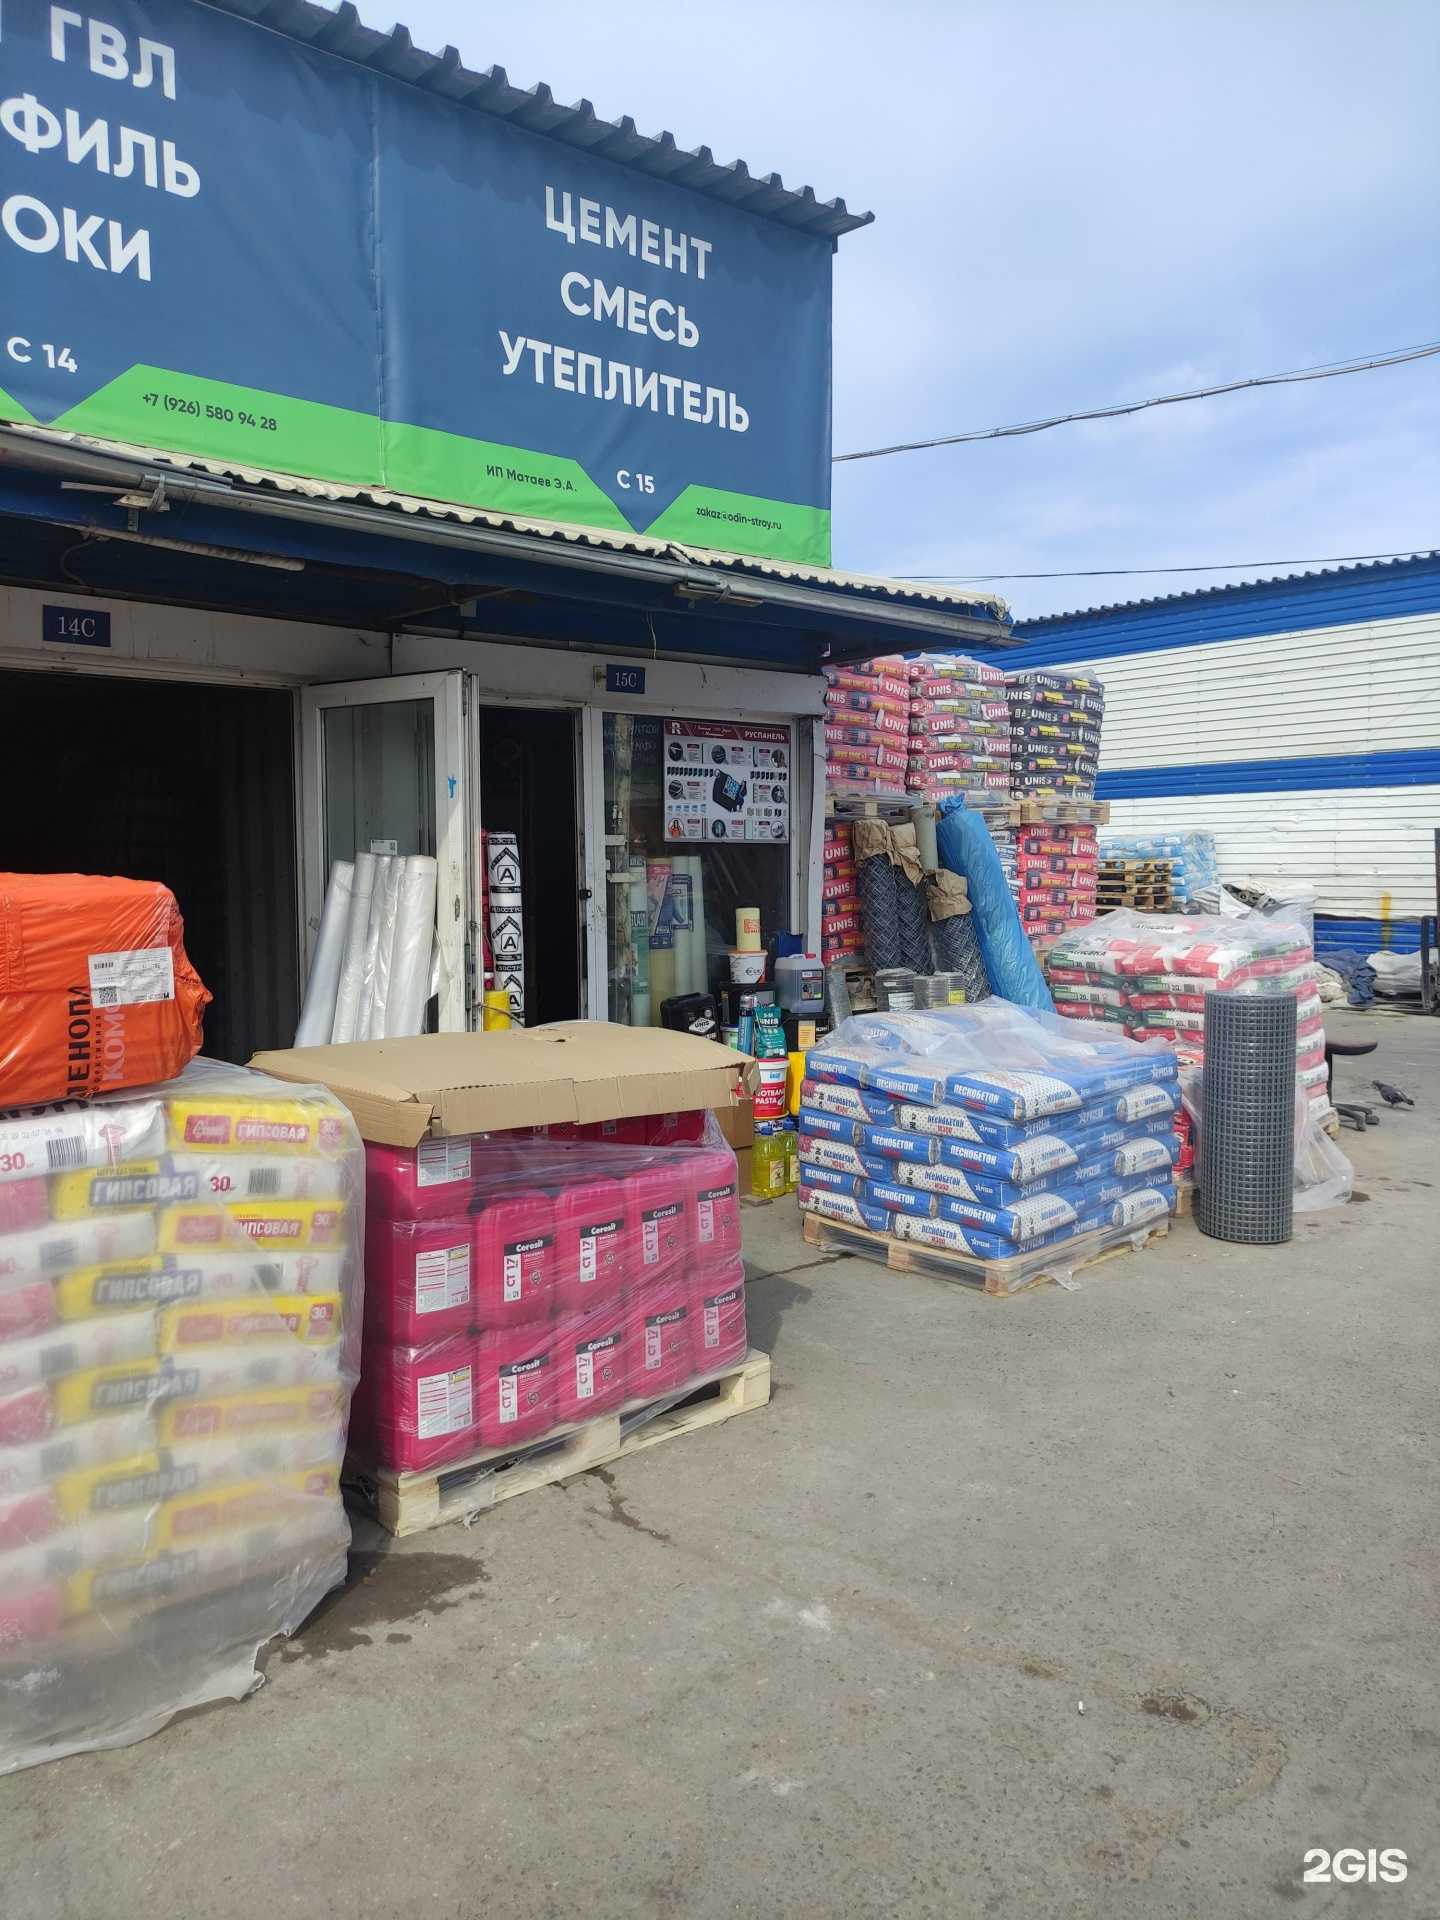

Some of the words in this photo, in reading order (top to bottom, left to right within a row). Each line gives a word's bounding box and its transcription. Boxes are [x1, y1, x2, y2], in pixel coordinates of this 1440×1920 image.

[50, 5, 176, 100] ГВЛ
[545, 185, 713, 280] ЦЕМЕНТ
[560, 271, 700, 348] СМЕСЬ
[42, 344, 78, 373] 14
[498, 330, 750, 433] УТЕПЛИТЕЛЬ
[142, 393, 159, 407] +7
[164, 394, 200, 417] (926)
[205, 404, 234, 422] 580
[238, 411, 256, 427] 94
[260, 416, 277, 431] 28
[486, 464, 504, 478] ИП
[506, 468, 551, 487] Матаев
[554, 477, 578, 493] Э.А.
[635, 473, 655, 494] 15
[929, 684, 952, 696] UNIS
[744, 730, 785, 741] РУСПАНЕЛЬ
[953, 1084, 1000, 1104] ПЕСКОБЕТОН
[872, 1135, 914, 1150] ПЕСКОБЕТОН
[1, 1152, 25, 1172] 30
[950, 1145, 997, 1165] ПЕСКОБЕТОН
[94, 1174, 197, 1203] ГИПСОВАЯ
[210, 1176, 232, 1192] 30
[873, 1187, 916, 1205] ПЕСКОБЕТОН
[950, 1202, 997, 1222] ПЕСКОБЕТОН
[591, 1223, 616, 1235] Ceresit
[516, 1240, 543, 1253] Ceresit
[583, 1256, 591, 1269] CT
[507, 1275, 516, 1287] CT
[312, 1305, 327, 1320] 30
[511, 1360, 540, 1374] Ceresit
[502, 1396, 511, 1408] CT
